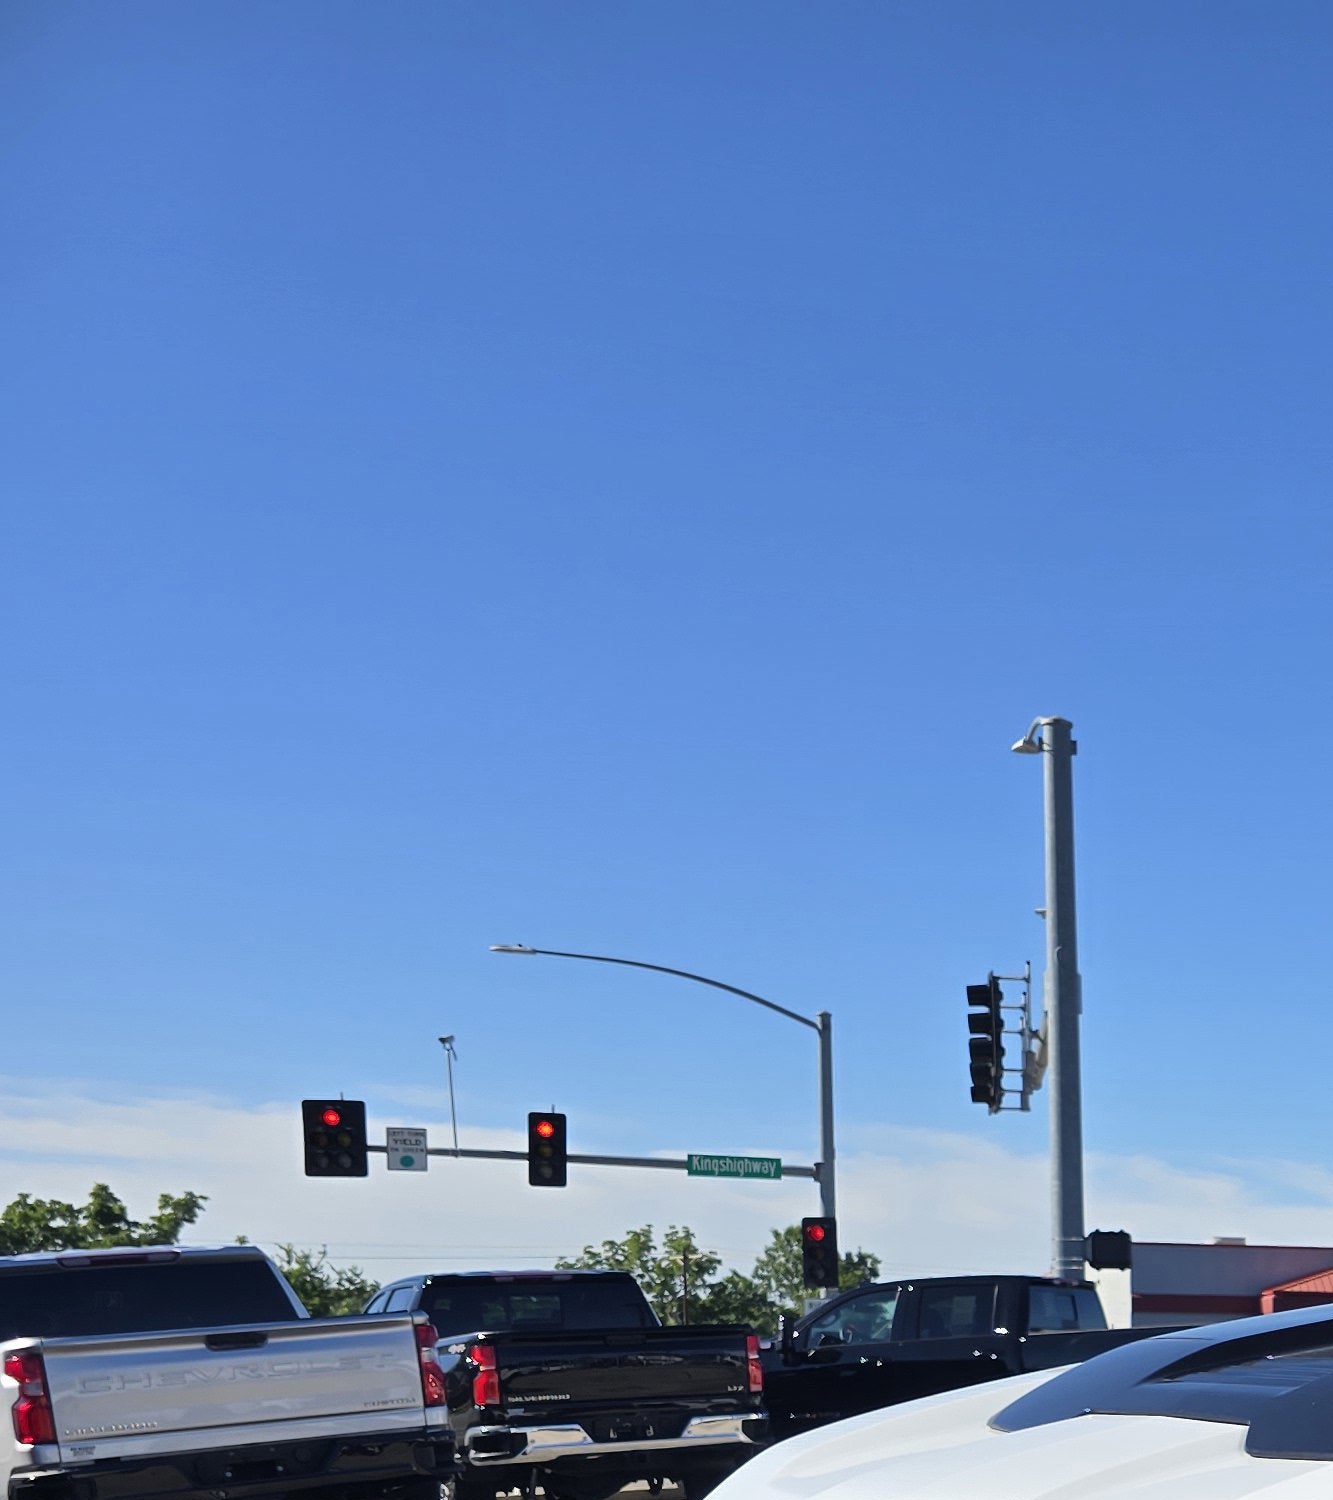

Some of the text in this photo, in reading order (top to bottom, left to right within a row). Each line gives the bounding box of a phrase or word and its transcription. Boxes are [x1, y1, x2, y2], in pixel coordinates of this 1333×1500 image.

[392, 1138, 422, 1146] YIELD
[692, 1156, 777, 1177] Kingshighway
[76, 1353, 395, 1394] CHEVROLET
